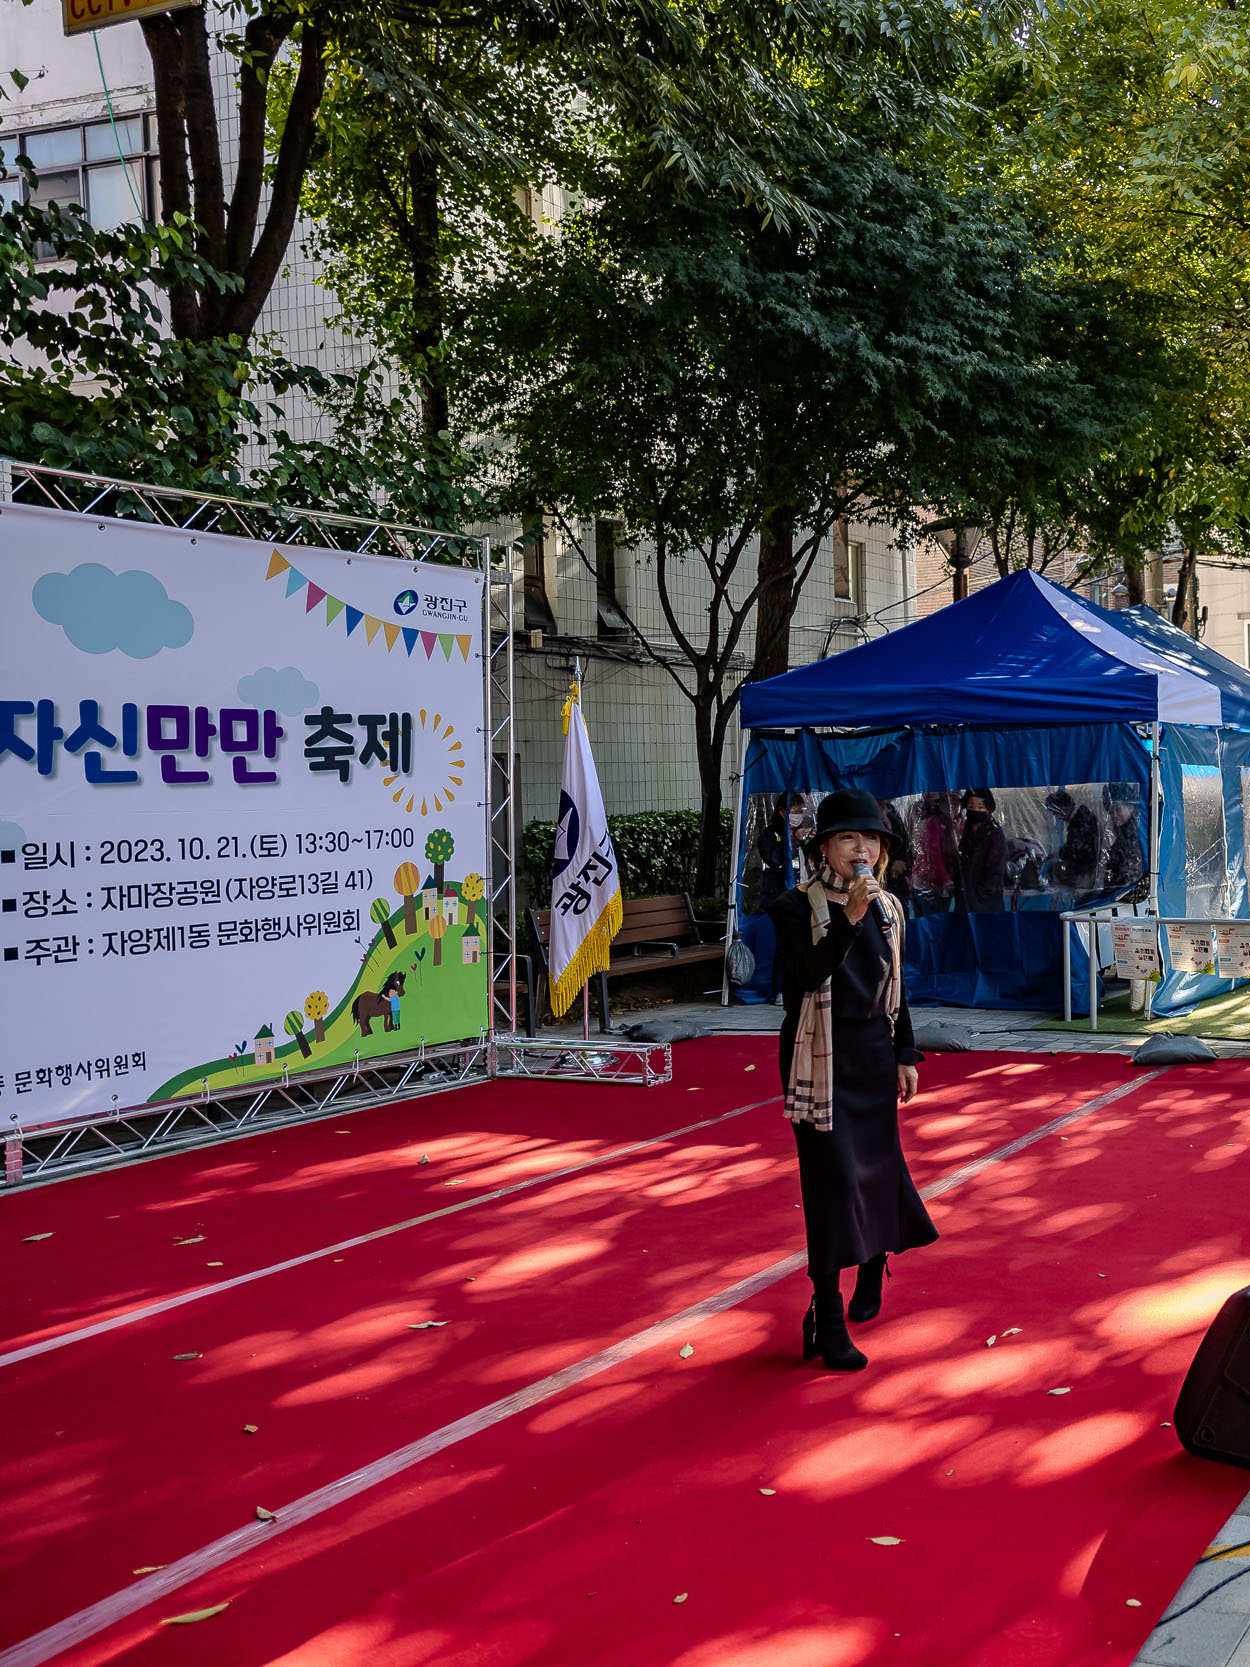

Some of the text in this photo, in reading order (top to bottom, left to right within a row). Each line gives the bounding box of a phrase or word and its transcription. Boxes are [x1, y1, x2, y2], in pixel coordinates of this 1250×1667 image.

[70, 0, 132, 19] CC
[422, 609, 468, 622] GWANGJIN-GU
[423, 594, 467, 613] 광진구
[0, 699, 412, 784] 자신만만 축제
[21, 841, 76, 871] 일시
[100, 839, 171, 865] 2023.
[178, 837, 211, 861] 10.
[296, 828, 414, 855] 13:30~17:00
[22, 889, 79, 919] 장소
[344, 868, 373, 892] 41)
[24, 935, 81, 966] 주관
[102, 923, 211, 958] 자양제1동
[217, 908, 361, 947] 문화행사위원회
[15, 1051, 147, 1094] 문화행사위원회
